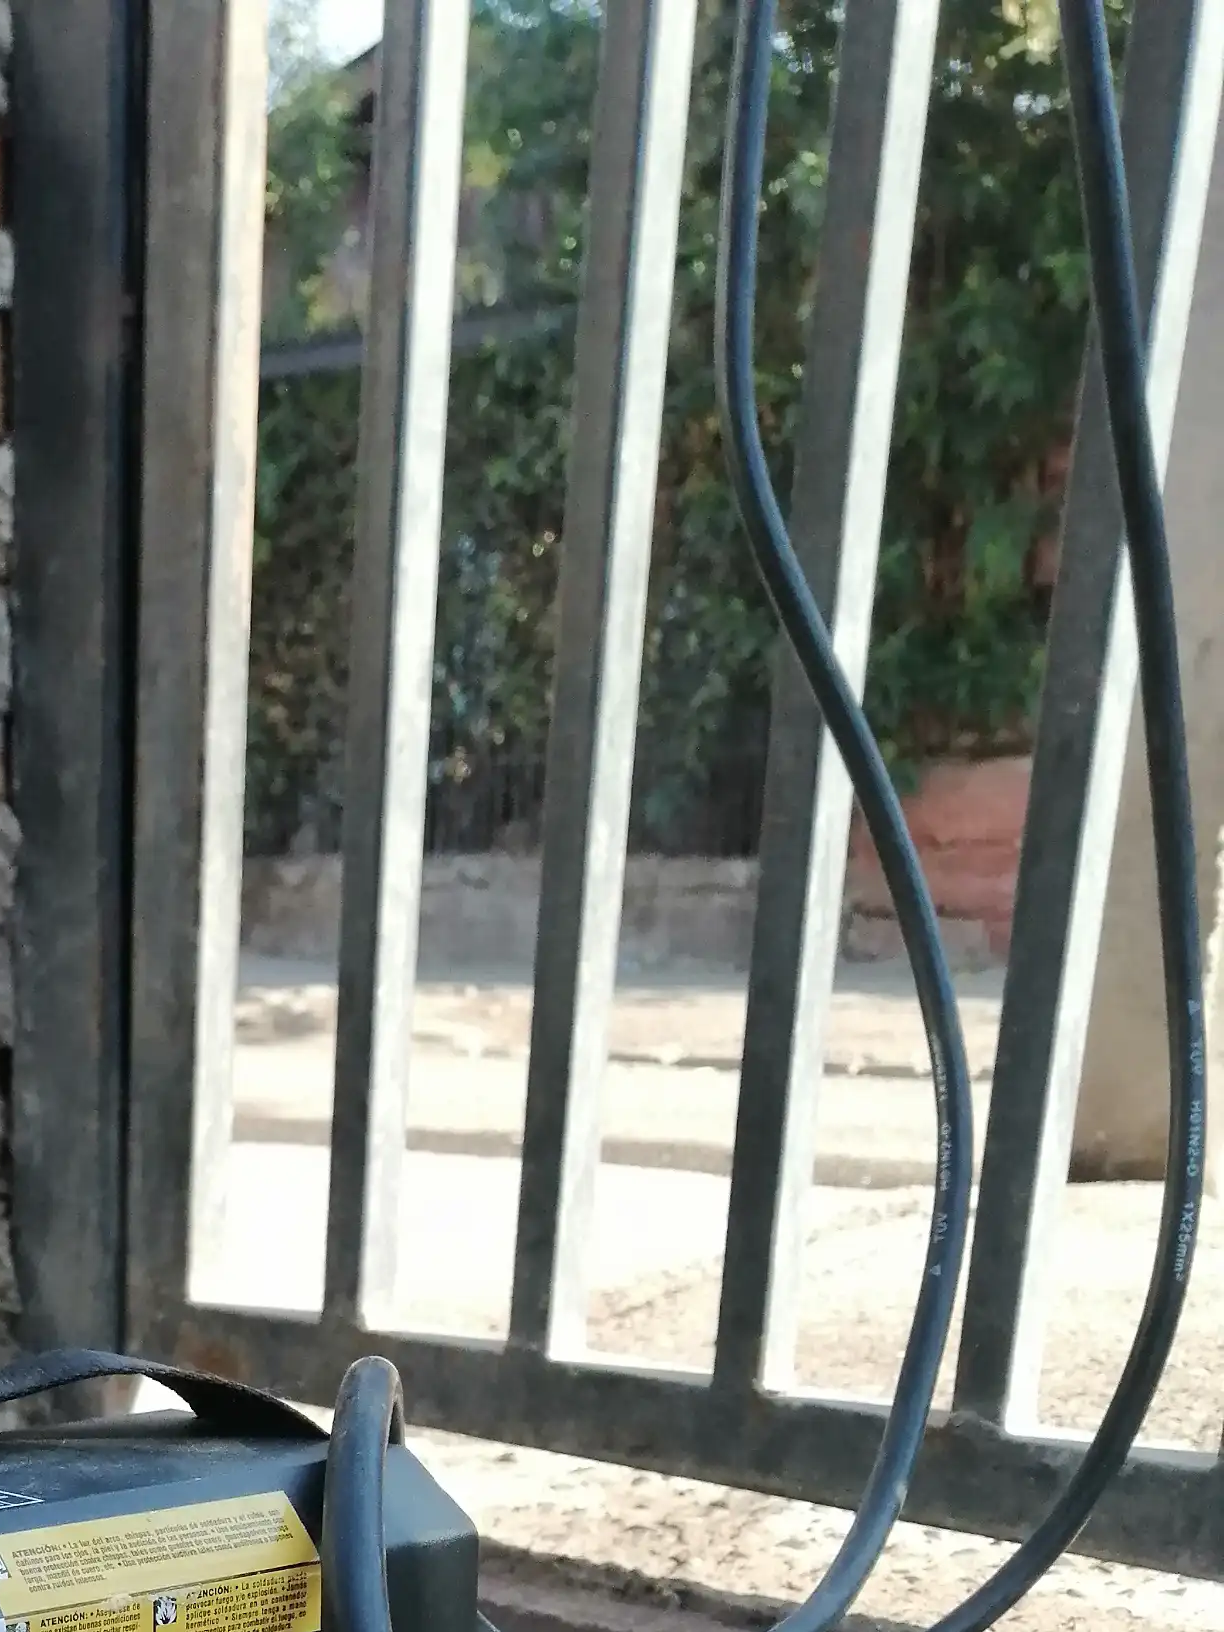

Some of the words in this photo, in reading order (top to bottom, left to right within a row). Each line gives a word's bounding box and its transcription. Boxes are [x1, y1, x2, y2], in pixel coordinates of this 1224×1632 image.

[11, 1544, 61, 1558] ATENCIÓN:
[241, 1582, 249, 1590] La
[215, 1595, 233, 1604] fuego
[249, 1600, 257, 1608] en
[260, 1598, 268, 1606] un
[40, 1610, 87, 1627] ATENCIÓN:
[132, 1602, 139, 1610] de
[78, 1620, 101, 1630] buenas
[103, 1612, 140, 1626] condiciones
[227, 1622, 240, 1632] para
[271, 1615, 276, 1623] el
